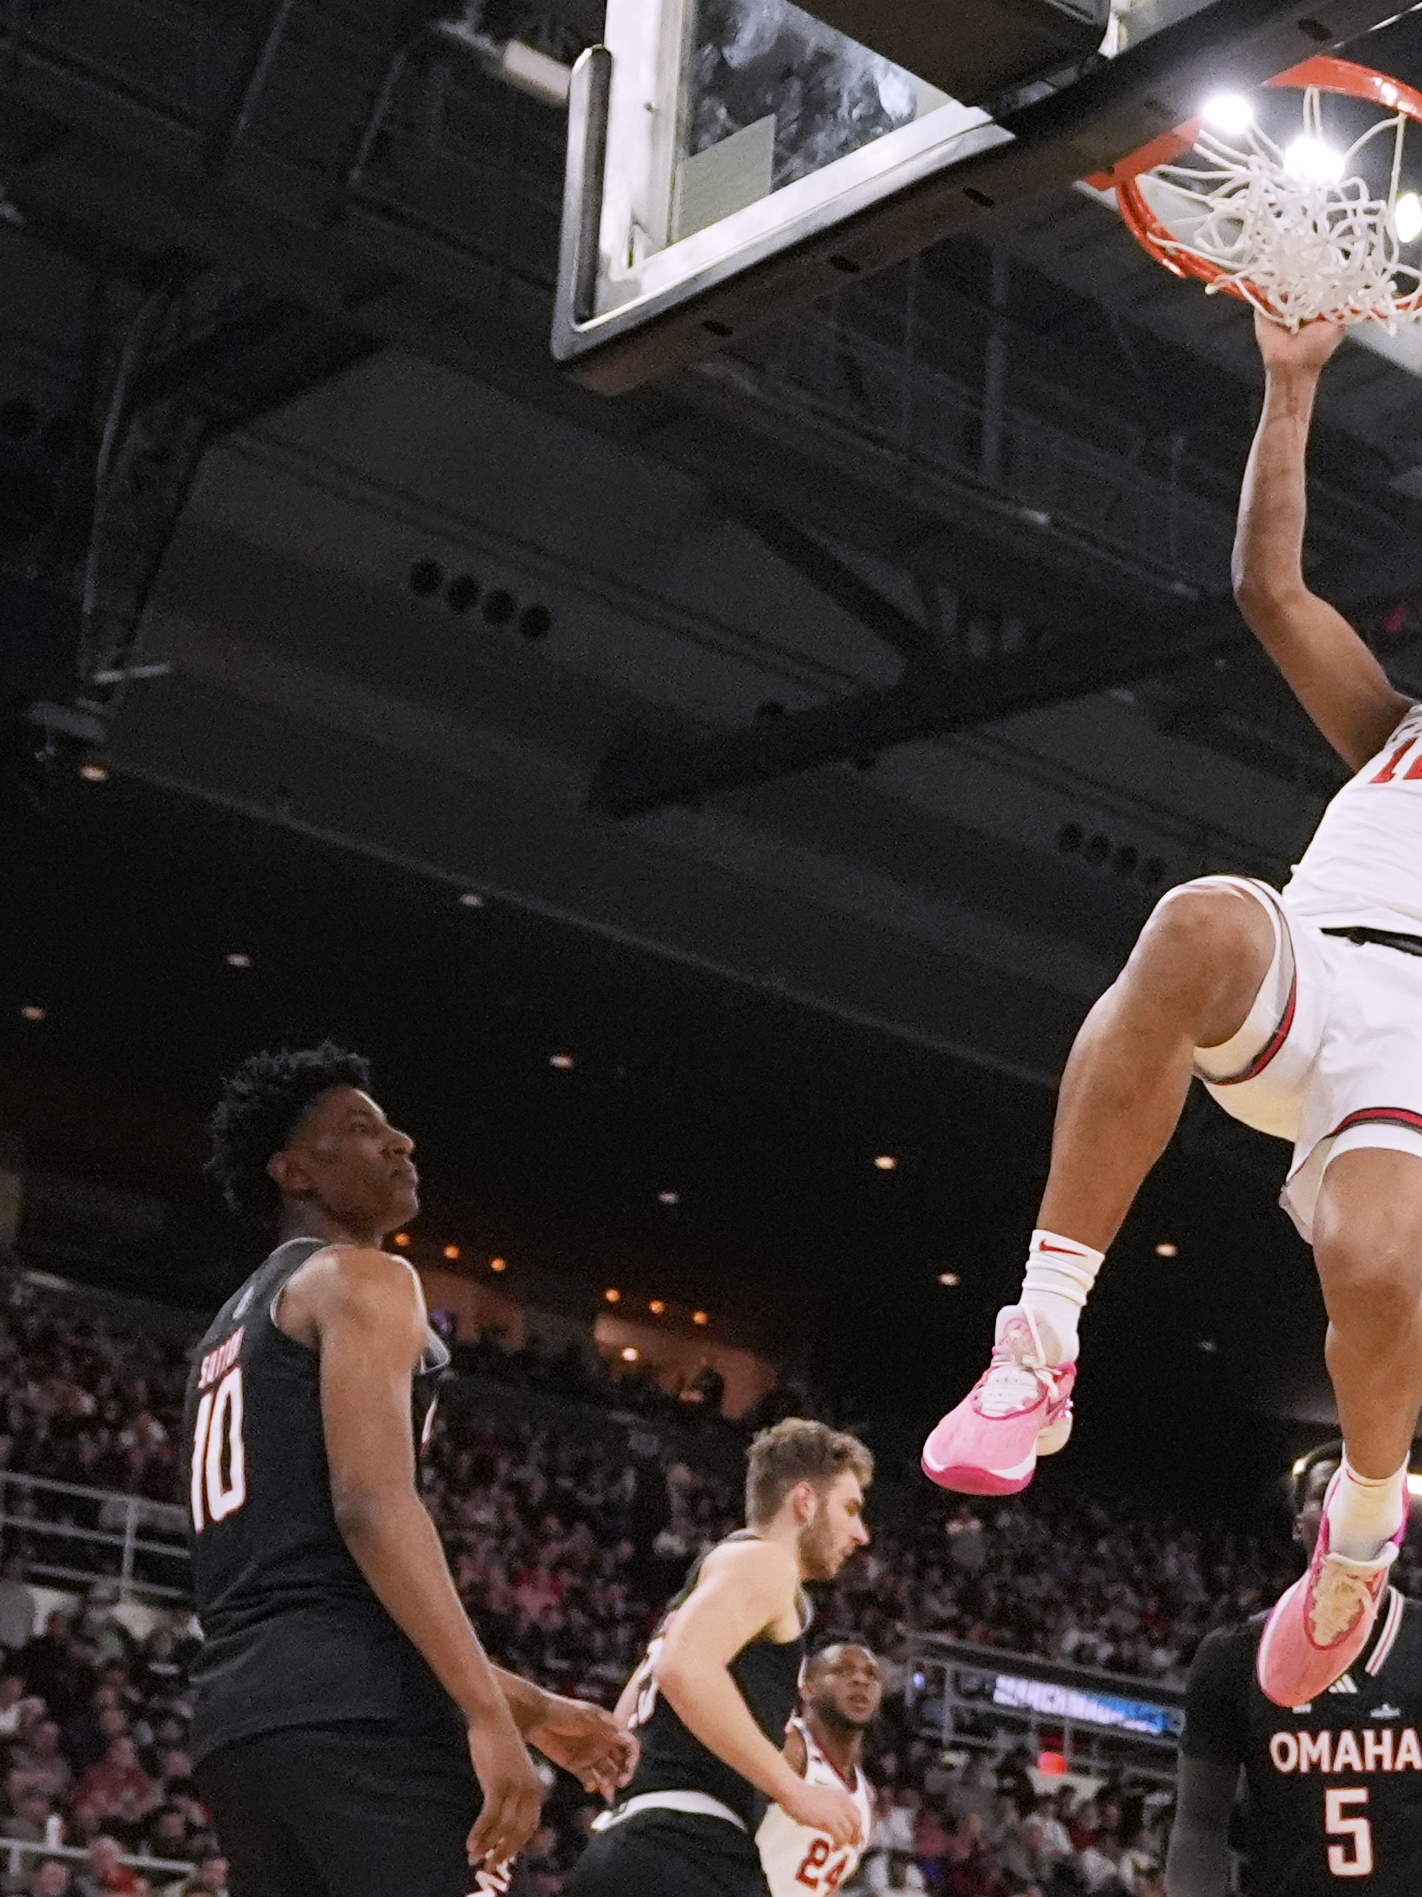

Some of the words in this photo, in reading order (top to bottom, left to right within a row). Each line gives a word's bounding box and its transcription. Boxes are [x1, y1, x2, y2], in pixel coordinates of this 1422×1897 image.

[191, 1365, 246, 1535] 10
[795, 1837, 849, 1897] 24
[1323, 1785, 1375, 1879] 5
